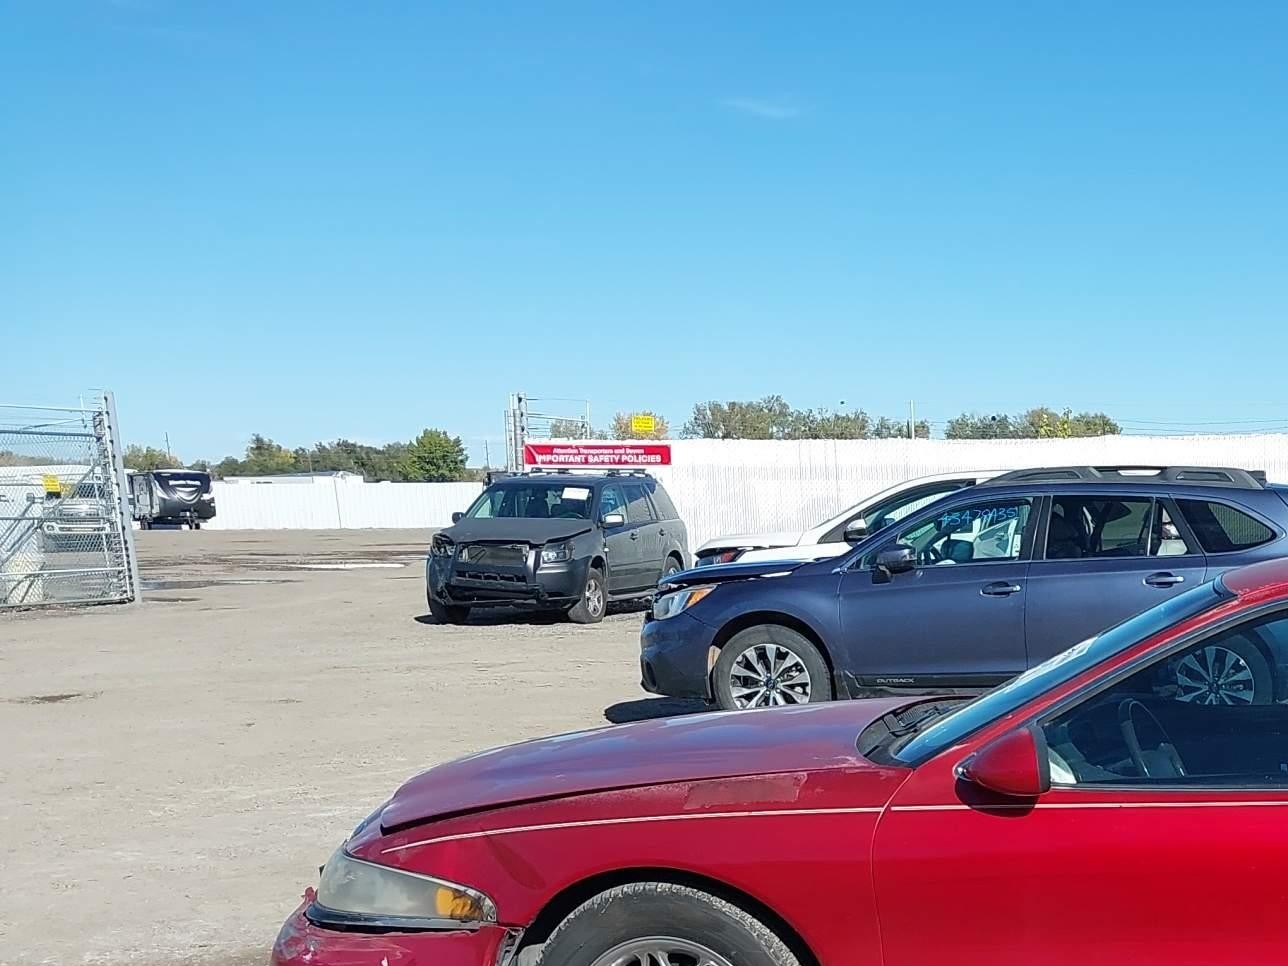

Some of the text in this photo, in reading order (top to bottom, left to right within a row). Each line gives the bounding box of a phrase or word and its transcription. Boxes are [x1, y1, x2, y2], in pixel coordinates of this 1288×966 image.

[536, 454, 661, 463] IMPORTANT SAFETY POLICIES
